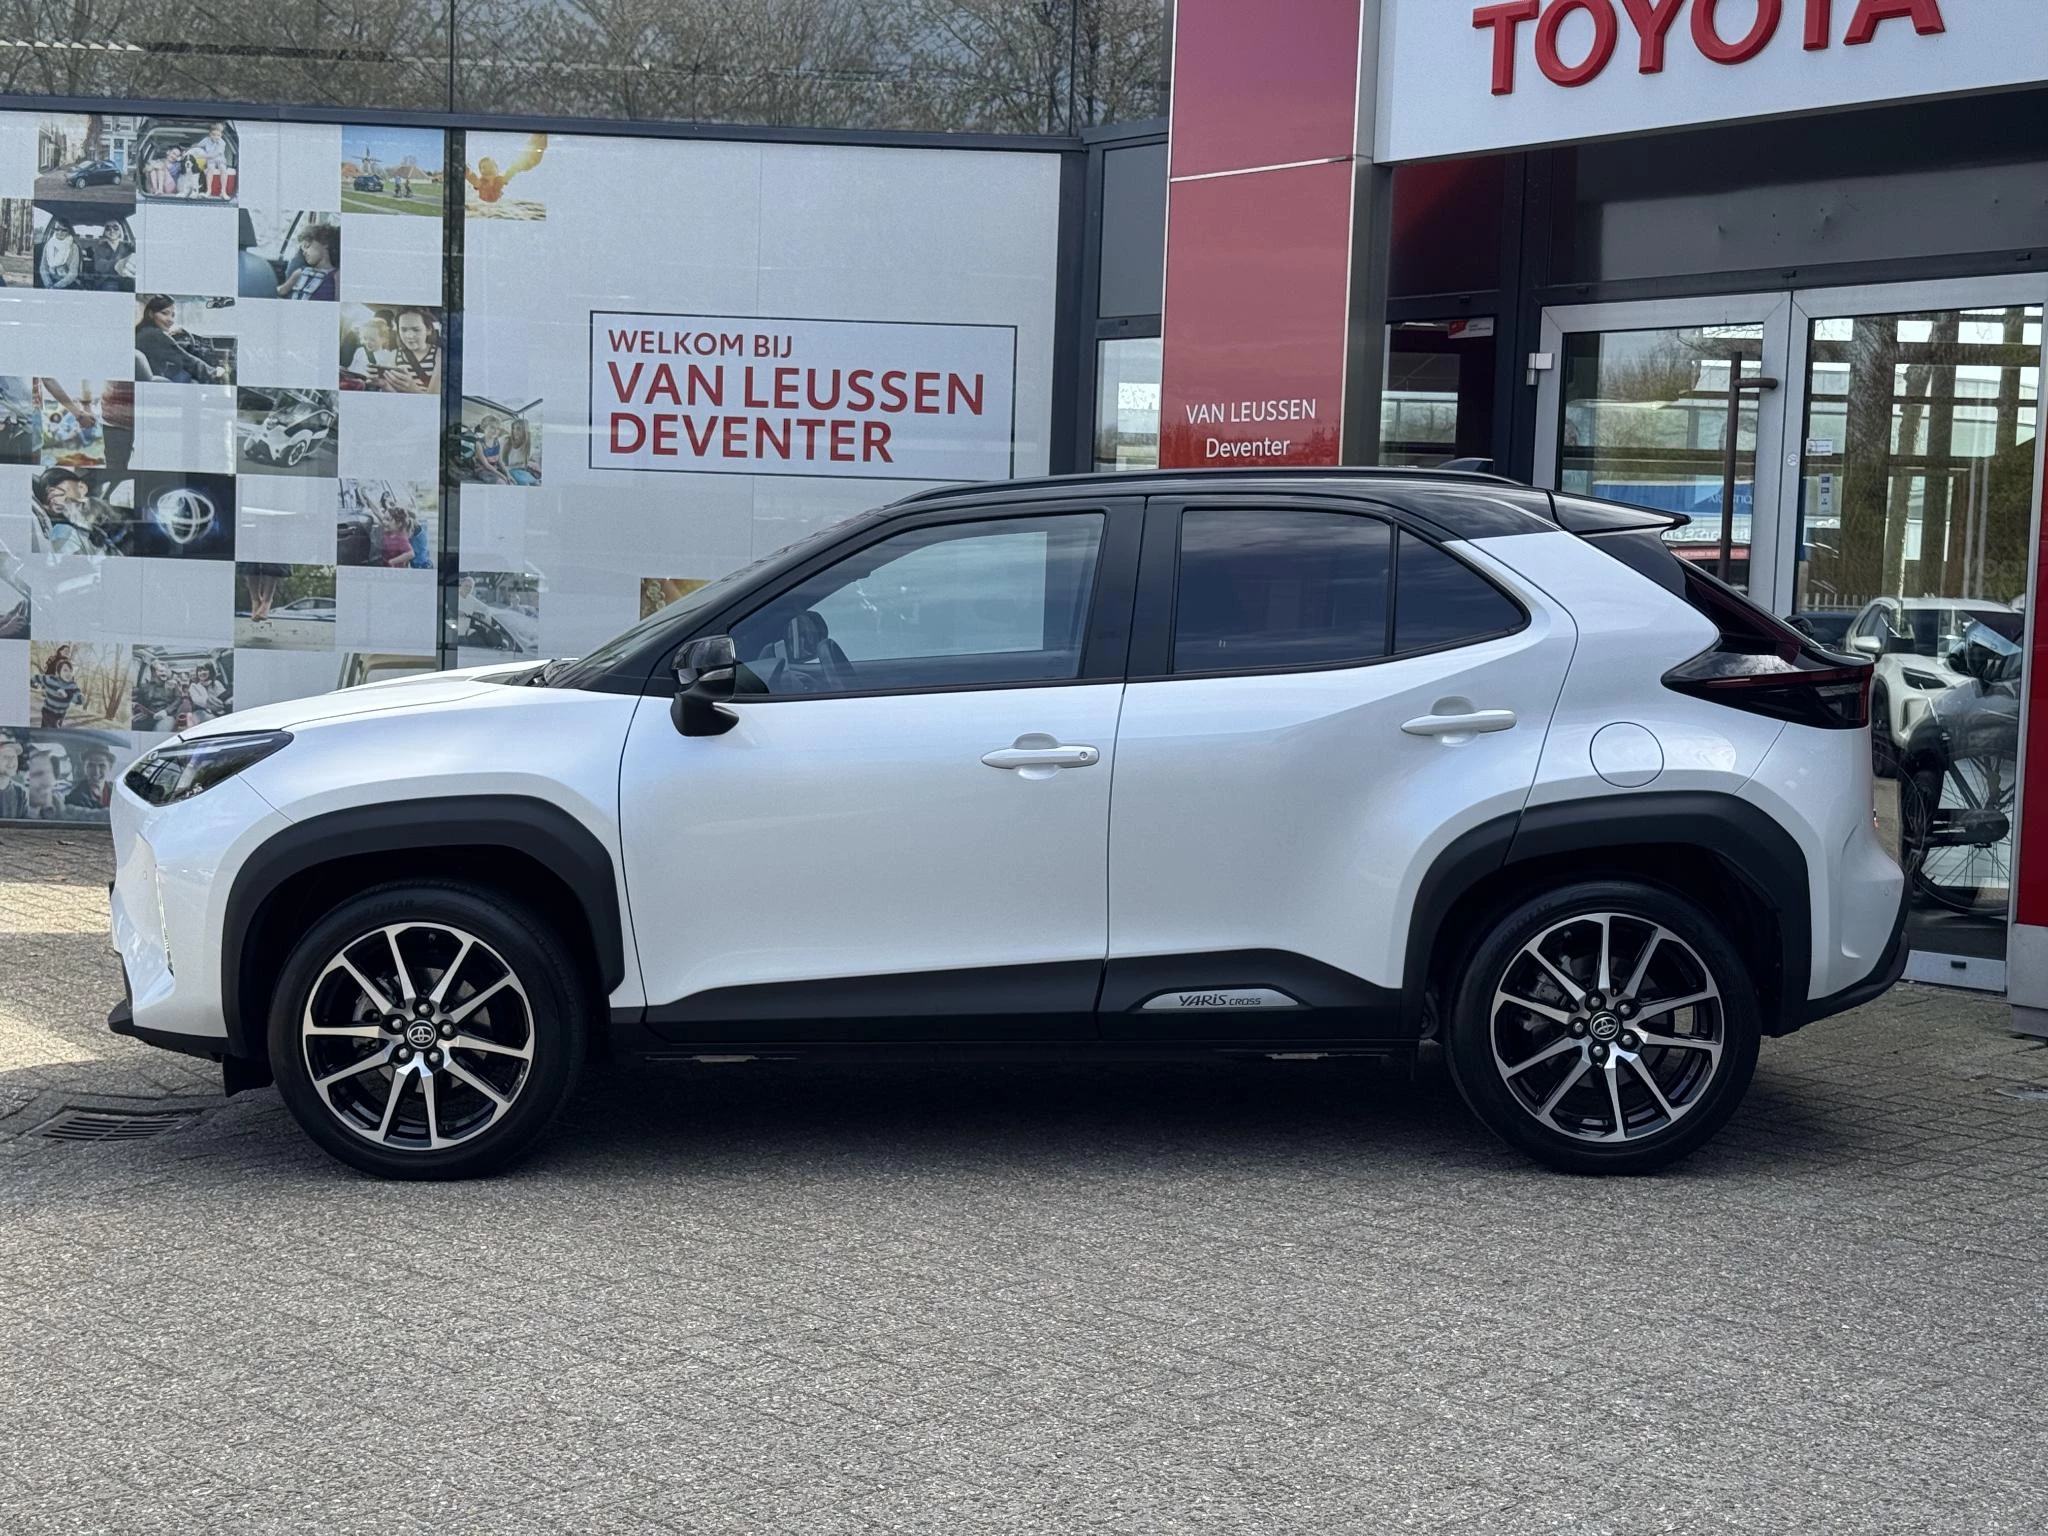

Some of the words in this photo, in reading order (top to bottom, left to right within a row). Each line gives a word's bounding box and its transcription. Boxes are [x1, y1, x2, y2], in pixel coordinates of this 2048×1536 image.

[608, 329, 744, 357] WELKOM
[754, 334, 793, 358] BIJ
[607, 361, 724, 407] VAN
[744, 366, 984, 416] LEUSSEN
[1185, 403, 1225, 425] VAN
[1230, 398, 1316, 423] LEUSSEN
[610, 412, 894, 463] DEVENTER
[1205, 437, 1291, 458] Deventer
[1229, 997, 1262, 1006] CROSS
